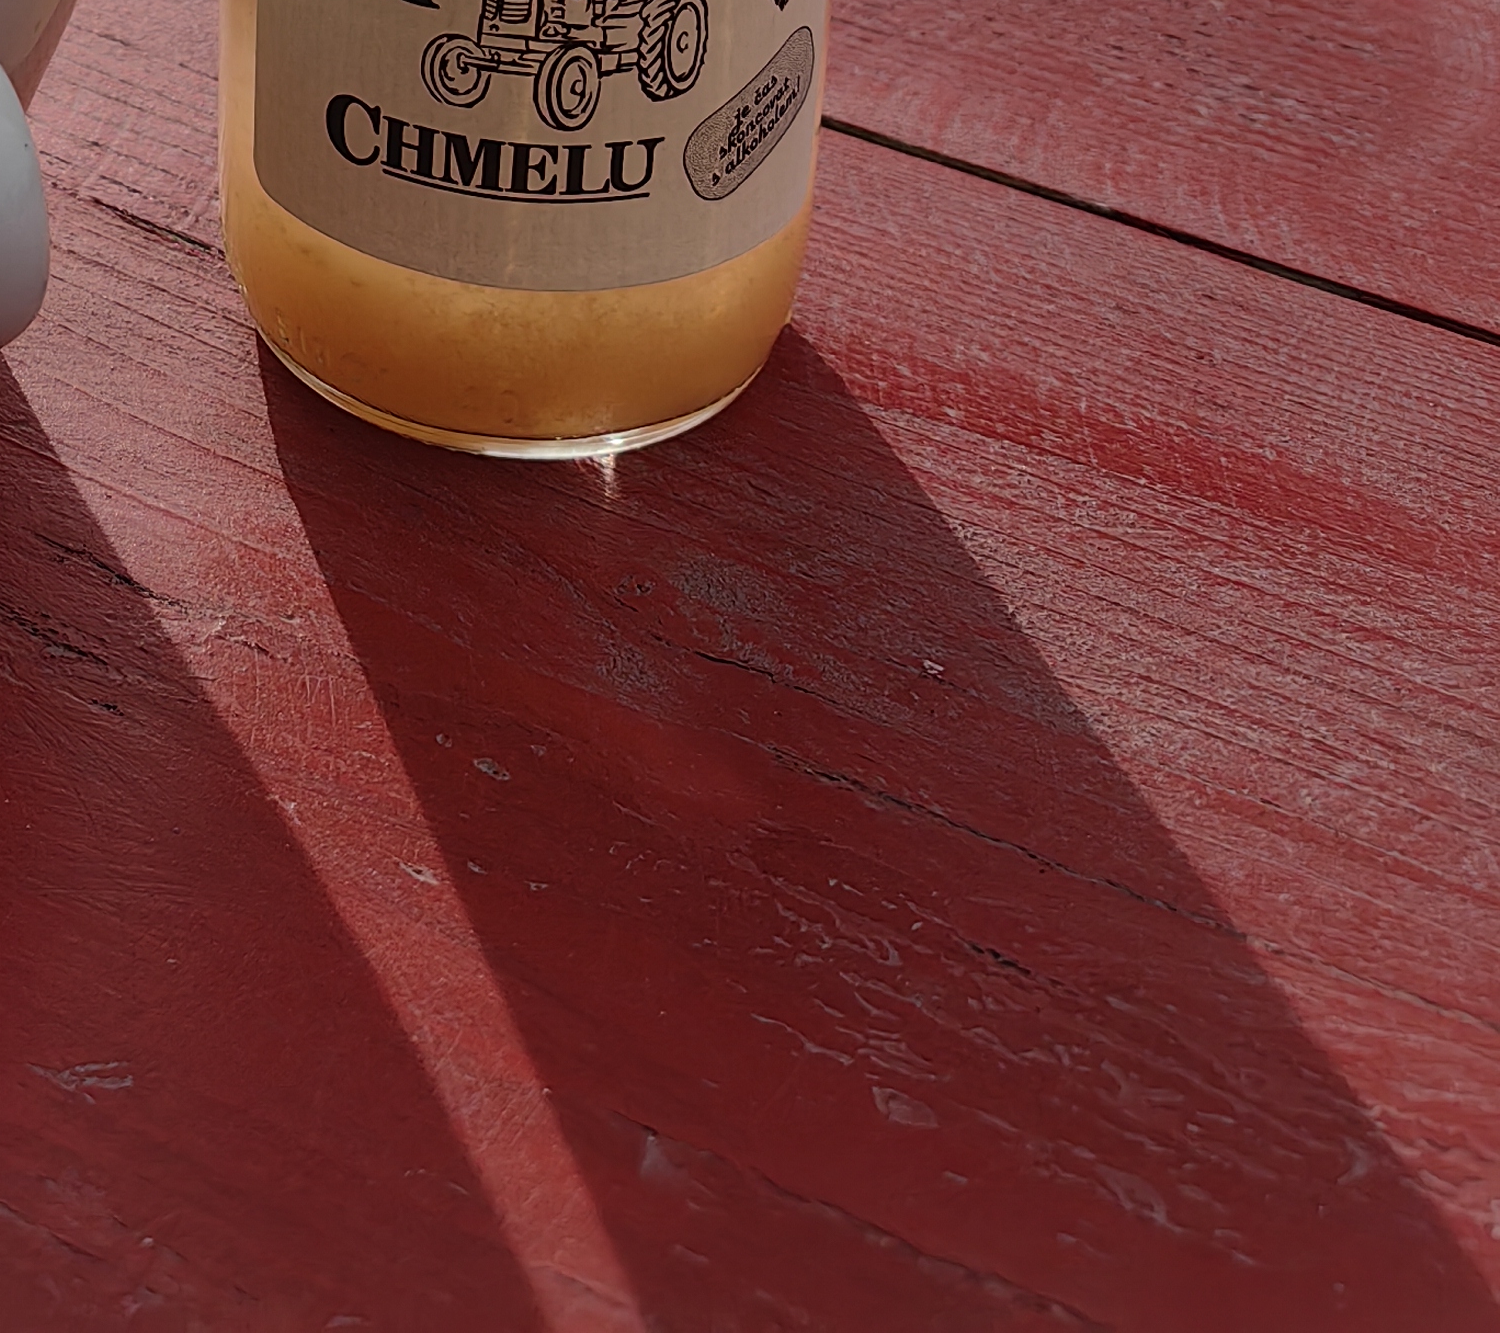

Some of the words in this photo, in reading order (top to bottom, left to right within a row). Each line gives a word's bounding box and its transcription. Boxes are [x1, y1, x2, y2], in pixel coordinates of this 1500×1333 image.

[719, 77, 790, 160] skoncovat
[754, 76, 777, 106] čas
[325, 93, 665, 204] CHMELU
